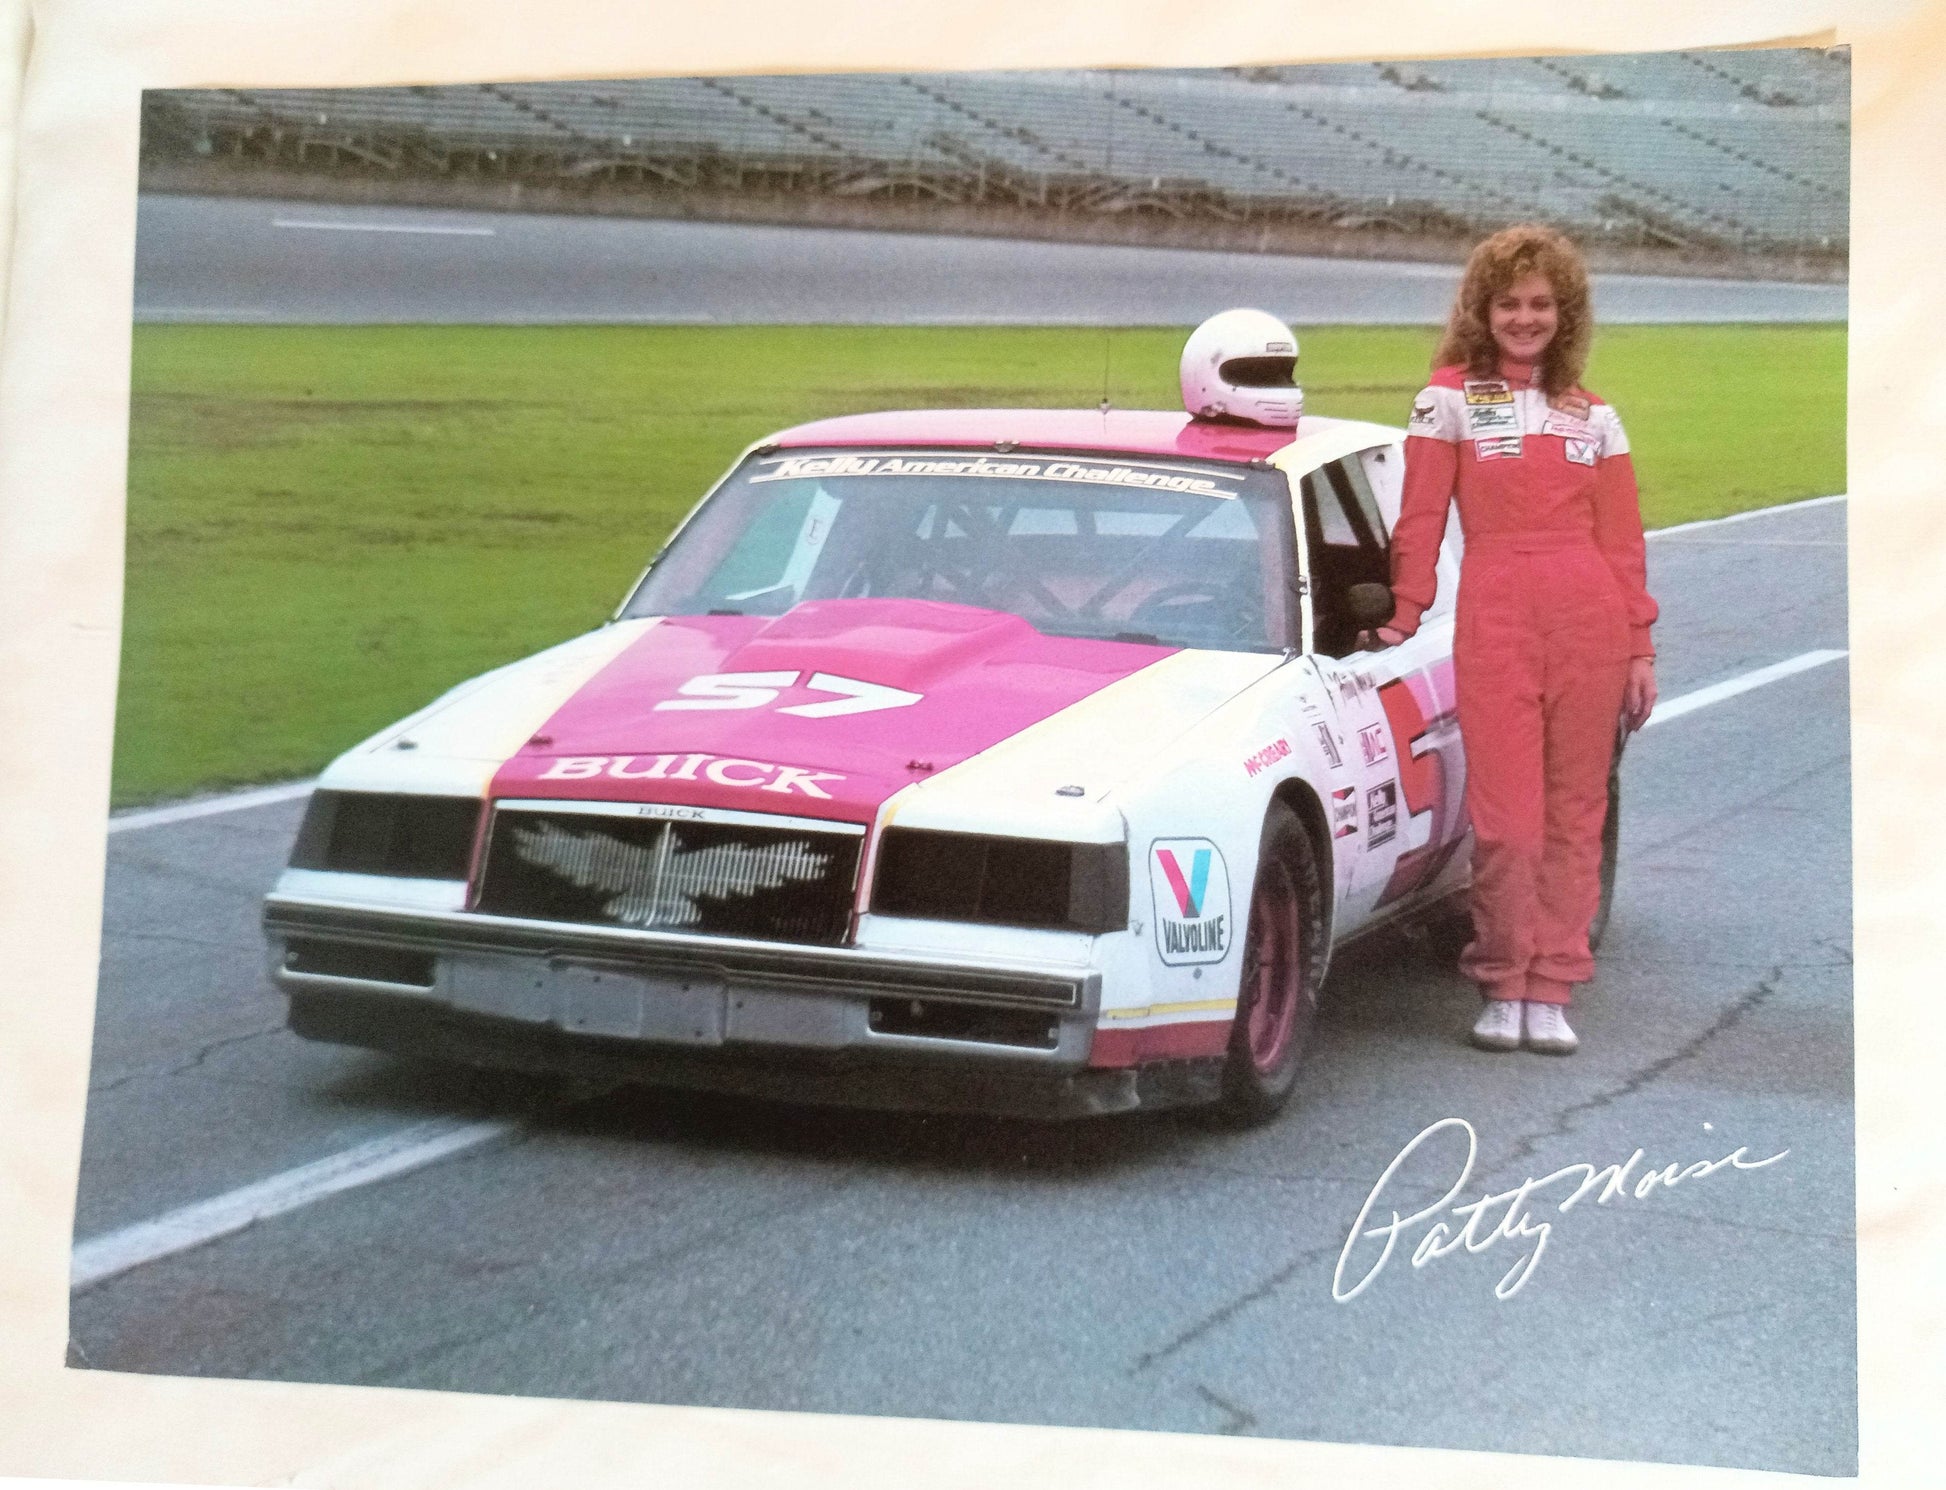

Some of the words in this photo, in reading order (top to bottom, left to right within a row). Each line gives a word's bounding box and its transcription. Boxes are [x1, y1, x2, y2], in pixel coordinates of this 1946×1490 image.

[774, 456, 879, 477] Kelly
[878, 457, 1041, 476] American
[1043, 462, 1216, 492] Challenge
[652, 670, 925, 719] 57
[537, 753, 848, 799] BUICK
[637, 806, 707, 820] BUICK
[1162, 914, 1224, 954] VALVOLINE
[1331, 1117, 1553, 1301] Patty
